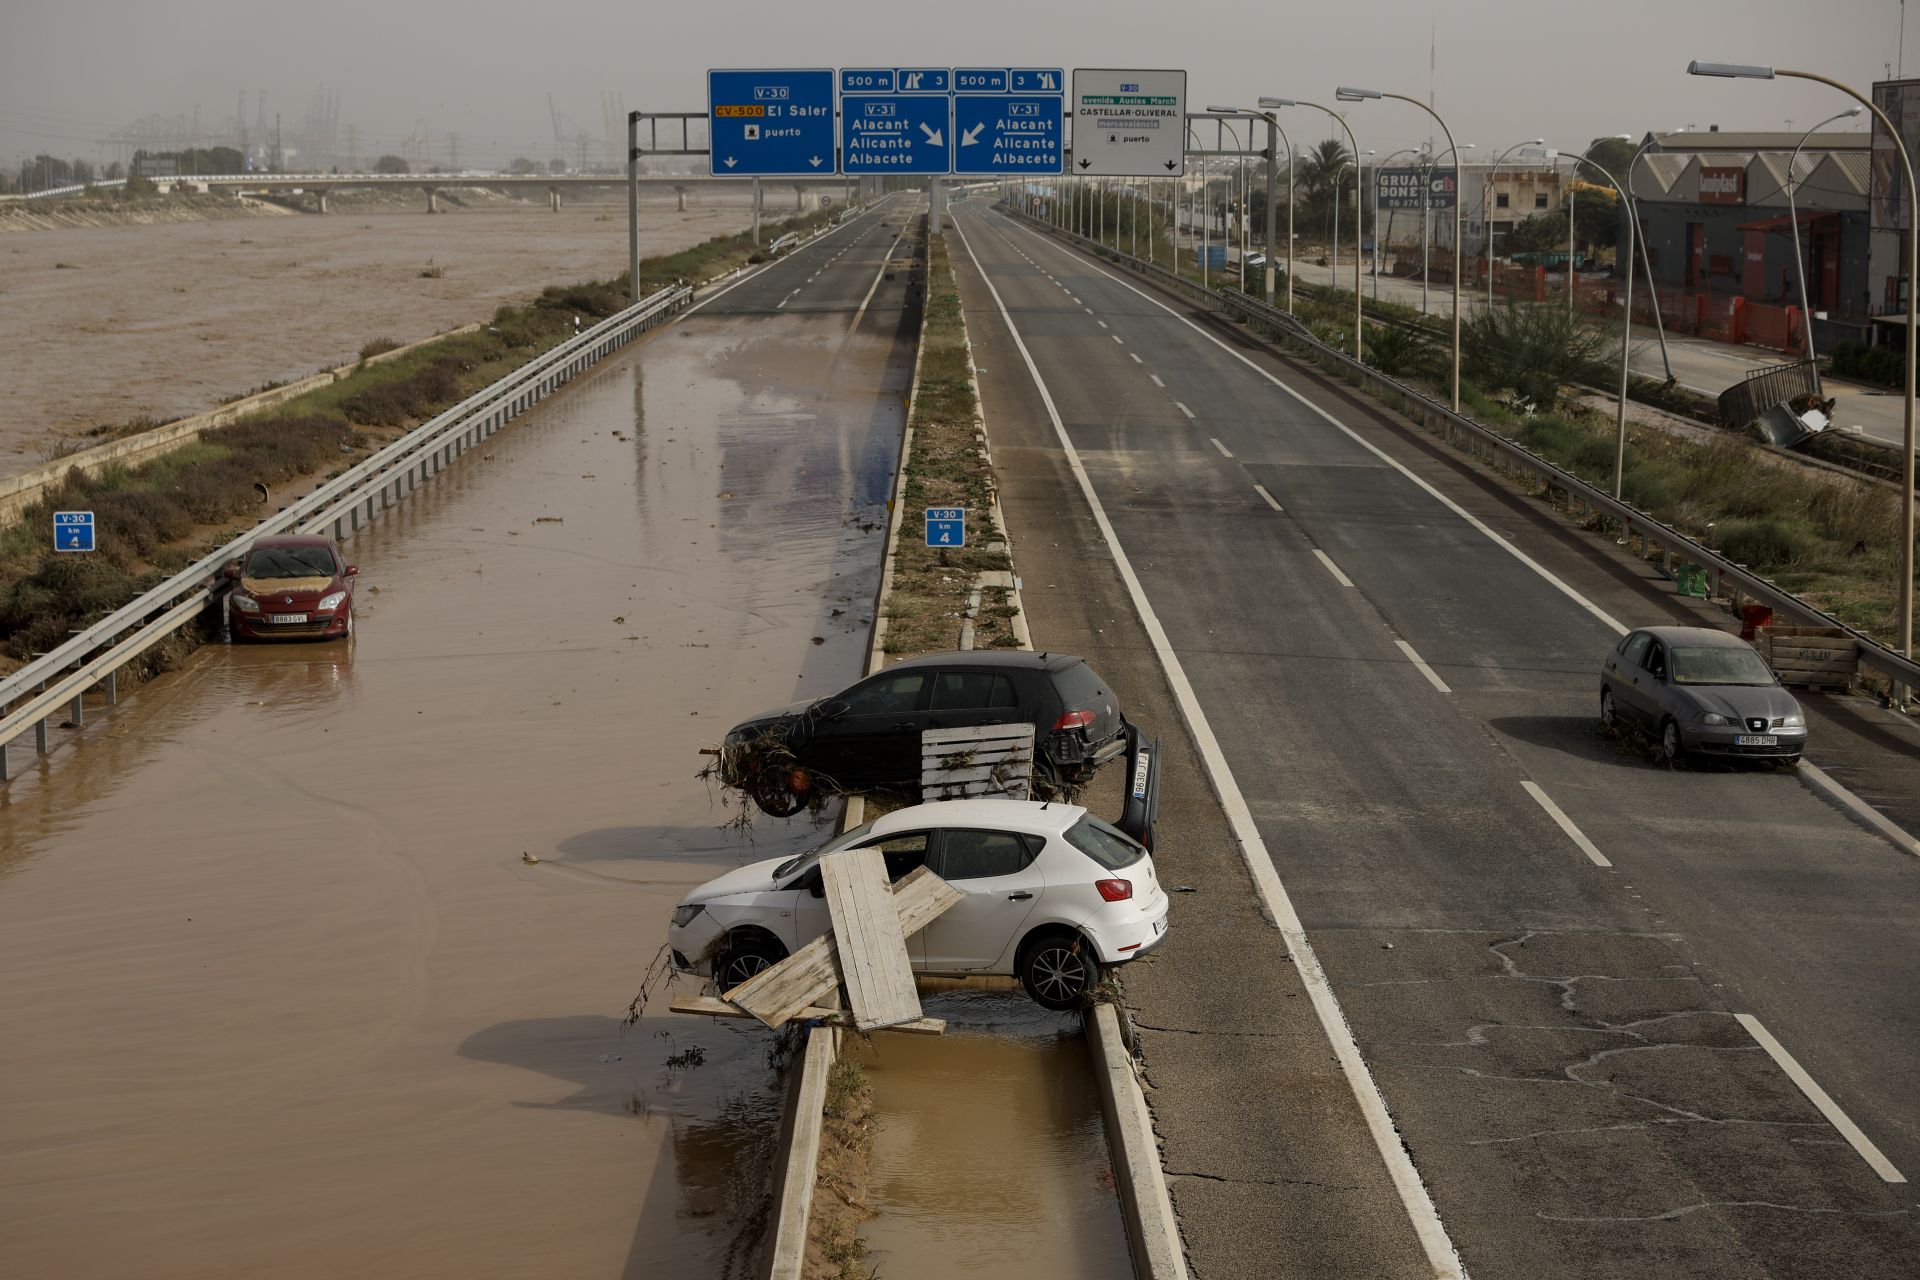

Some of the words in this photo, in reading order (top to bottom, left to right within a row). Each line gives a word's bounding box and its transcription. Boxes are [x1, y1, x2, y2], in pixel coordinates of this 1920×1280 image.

[848, 77, 872, 86] 500
[878, 78, 888, 86] m
[936, 77, 943, 86] 3
[960, 77, 985, 86] 500
[991, 78, 1001, 86] m
[1017, 77, 1024, 86] 3
[756, 89, 786, 98] V-30
[1083, 96, 1114, 104] avenida
[1119, 97, 1146, 105] Ausias
[1150, 97, 1175, 105] March
[716, 107, 763, 116] CV-500
[768, 105, 782, 116] El
[789, 105, 827, 116] Saler
[867, 106, 894, 114] V-31
[1011, 106, 1038, 114] V-31
[1080, 108, 1177, 117] CASTELLAR-OLIVERAL
[852, 119, 909, 130] Alacant
[995, 119, 1053, 130] Alacant
[765, 127, 801, 137] puerto
[850, 138, 912, 149] Alicante
[993, 138, 1055, 149] Alicante
[1123, 135, 1150, 143] puerto
[849, 153, 913, 164] Albacete
[992, 153, 1056, 164] Albacete
[62, 514, 85, 523] V-30
[933, 510, 956, 518] V-30
[70, 536, 79, 547] 4
[939, 532, 950, 544] 4
[1761, 736, 1776, 745] DHR
[1138, 755, 1148, 771] JTJ
[1135, 772, 1146, 793] 9630
